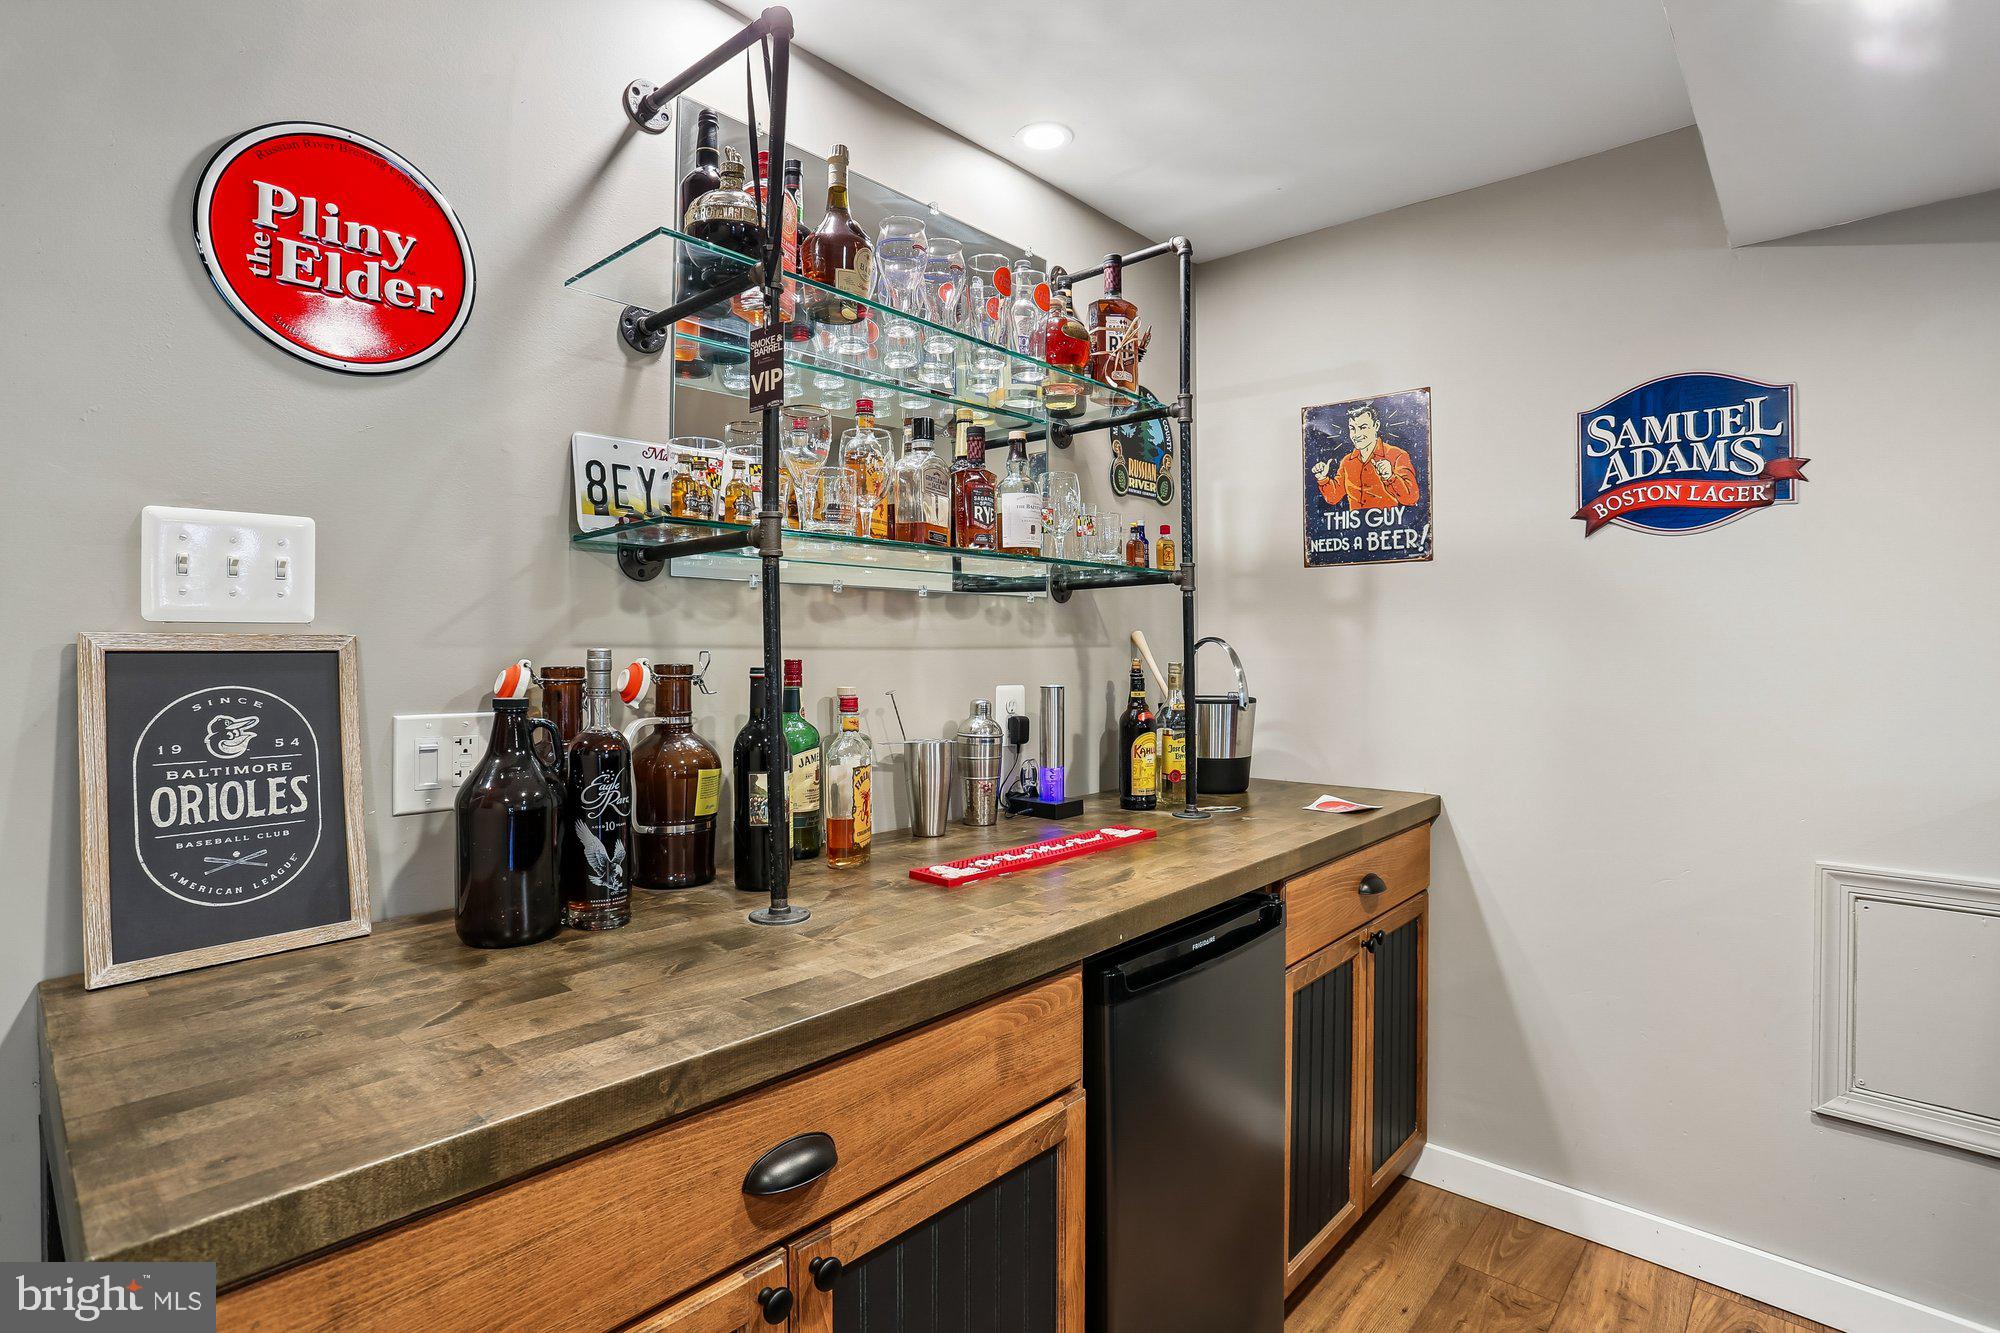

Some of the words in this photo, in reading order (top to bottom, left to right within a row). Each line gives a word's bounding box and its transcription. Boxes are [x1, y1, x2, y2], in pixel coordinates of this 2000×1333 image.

[252, 179, 417, 271] Pliny
[246, 231, 272, 278] the
[276, 236, 444, 314] Elder
[750, 334, 776, 350] SMOKE
[776, 333, 783, 341] &
[754, 342, 783, 358] BARREL
[751, 367, 783, 395] VIP
[1586, 395, 1784, 458] SAMUEL
[1128, 458, 1157, 482] RUSSIAN
[1598, 437, 1766, 492] ADAMS
[1128, 477, 1157, 493] RIVER
[973, 505, 995, 525] RYE
[1592, 485, 1683, 520] BOSTON
[1687, 485, 1768, 502] LAGER
[1323, 509, 1361, 531] THIS
[1364, 506, 1406, 528] GUY
[1310, 537, 1350, 553] NEEDS
[1353, 536, 1363, 550] A
[1366, 523, 1430, 553] BEER!
[192, 697, 264, 712] SINCE
[157, 744, 182, 755] 19
[275, 737, 300, 748] 54
[166, 762, 293, 781] BALTIMORE
[150, 774, 309, 828] ORIOLES
[581, 767, 626, 810] Eagle
[588, 789, 631, 819] Rare
[175, 835, 250, 850] BASEBALL
[257, 829, 291, 840] CLUB
[605, 821, 616, 832] 10
[169, 871, 244, 896] AMERICAN
[253, 852, 298, 890] LEAGUE
[1192, 935, 1216, 951] FRIGIDAIRE
